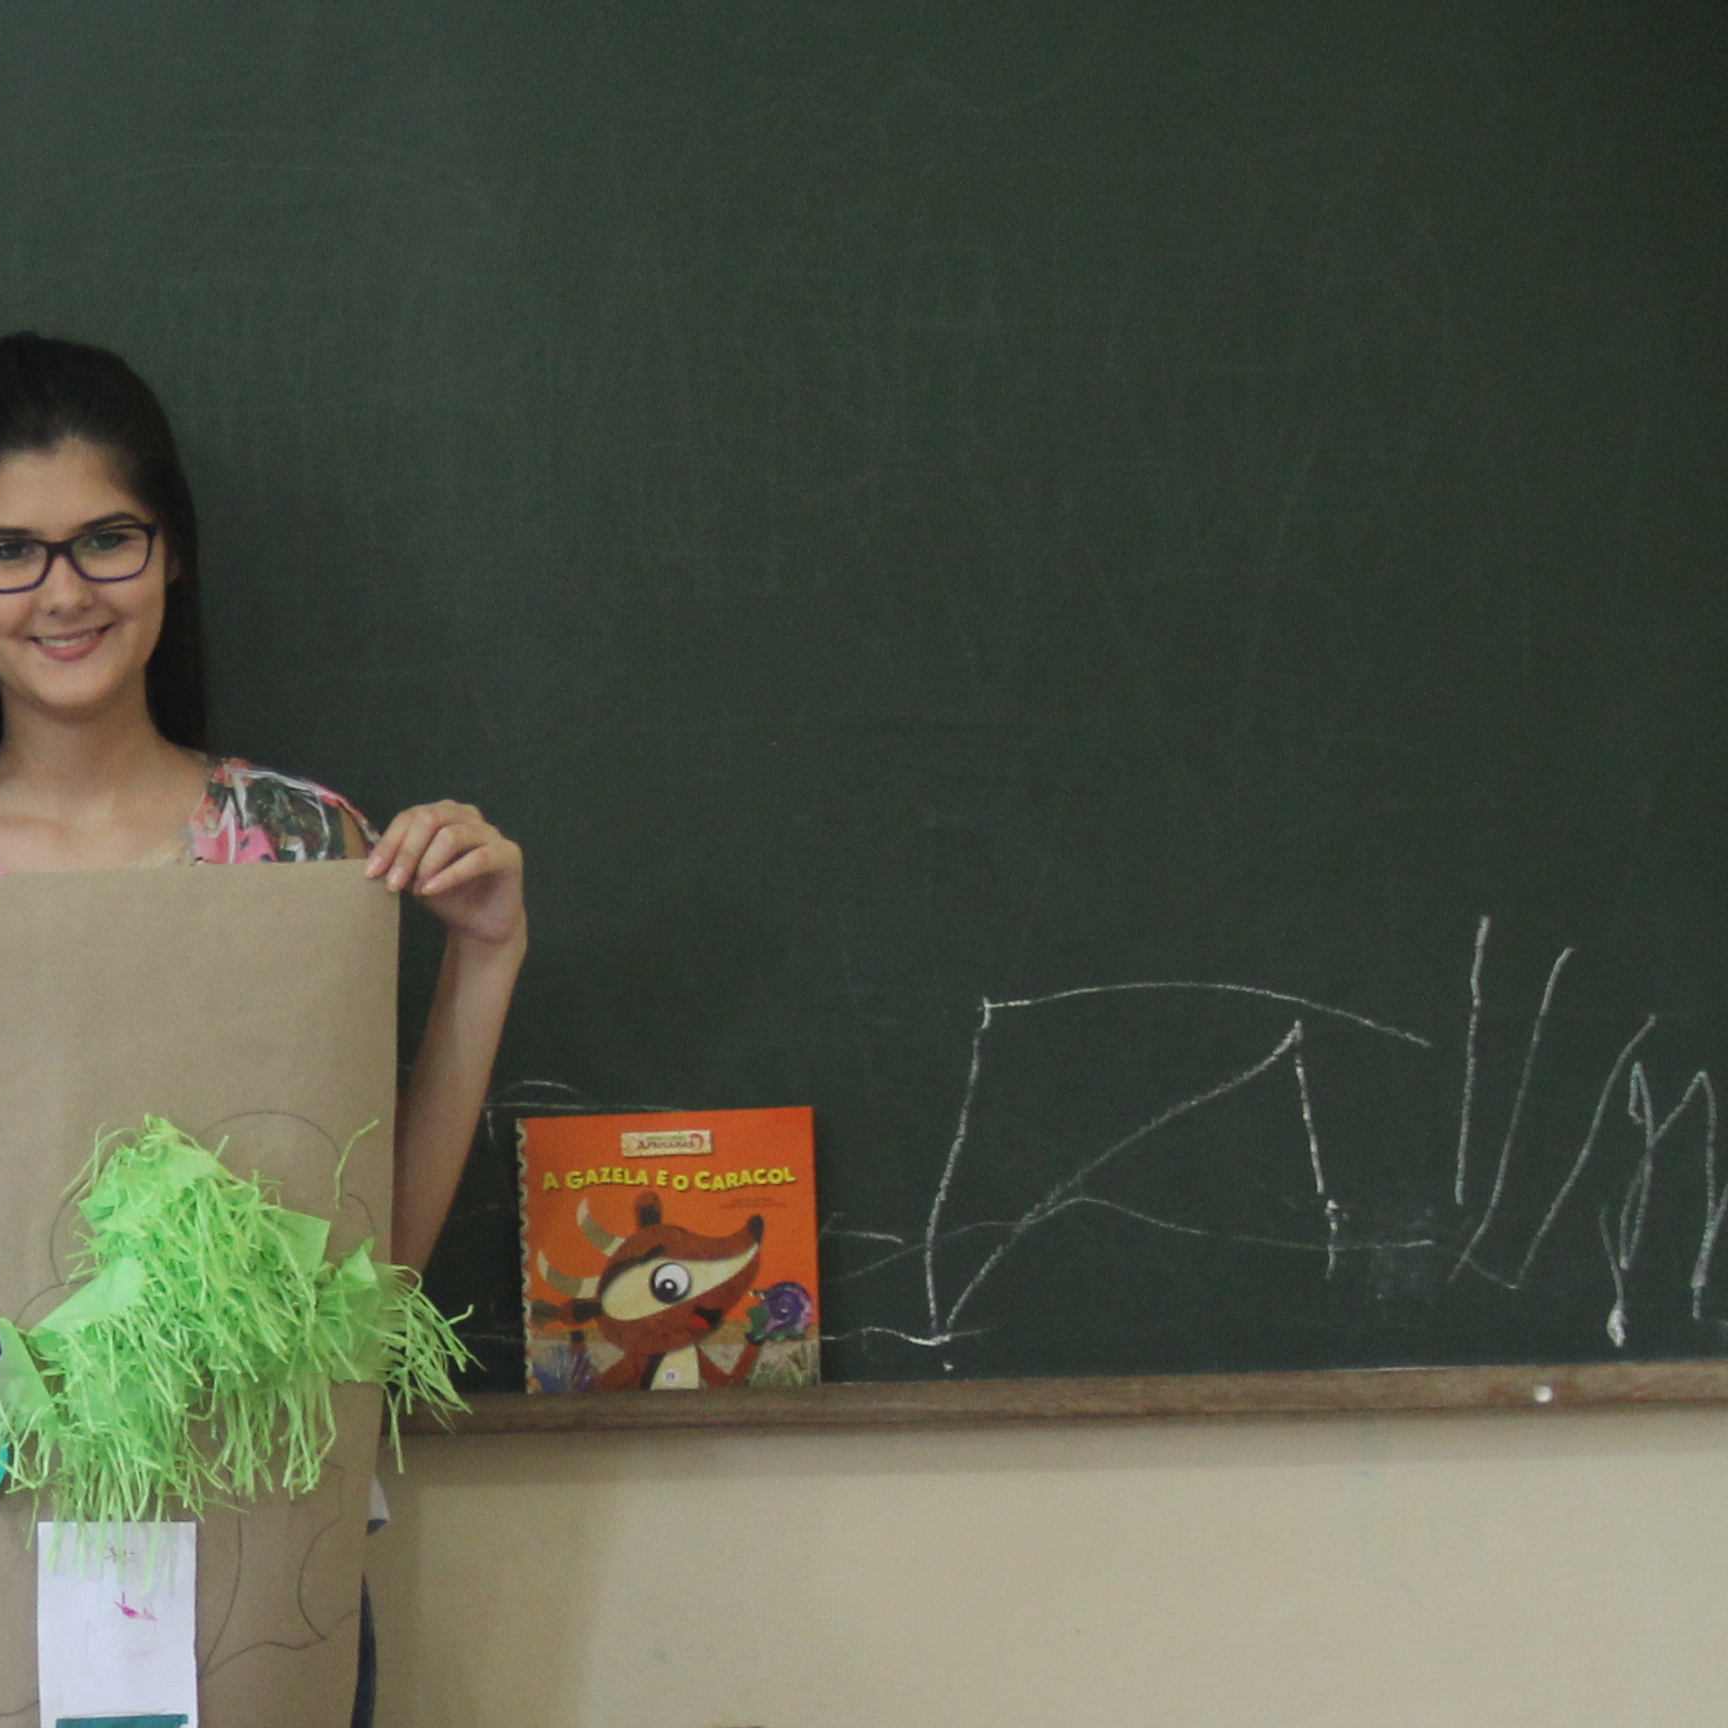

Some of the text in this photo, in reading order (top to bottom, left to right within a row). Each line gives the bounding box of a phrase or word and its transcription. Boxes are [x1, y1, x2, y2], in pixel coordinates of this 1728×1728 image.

[543, 1166, 797, 1191] A GAZELA E O CARACOL
